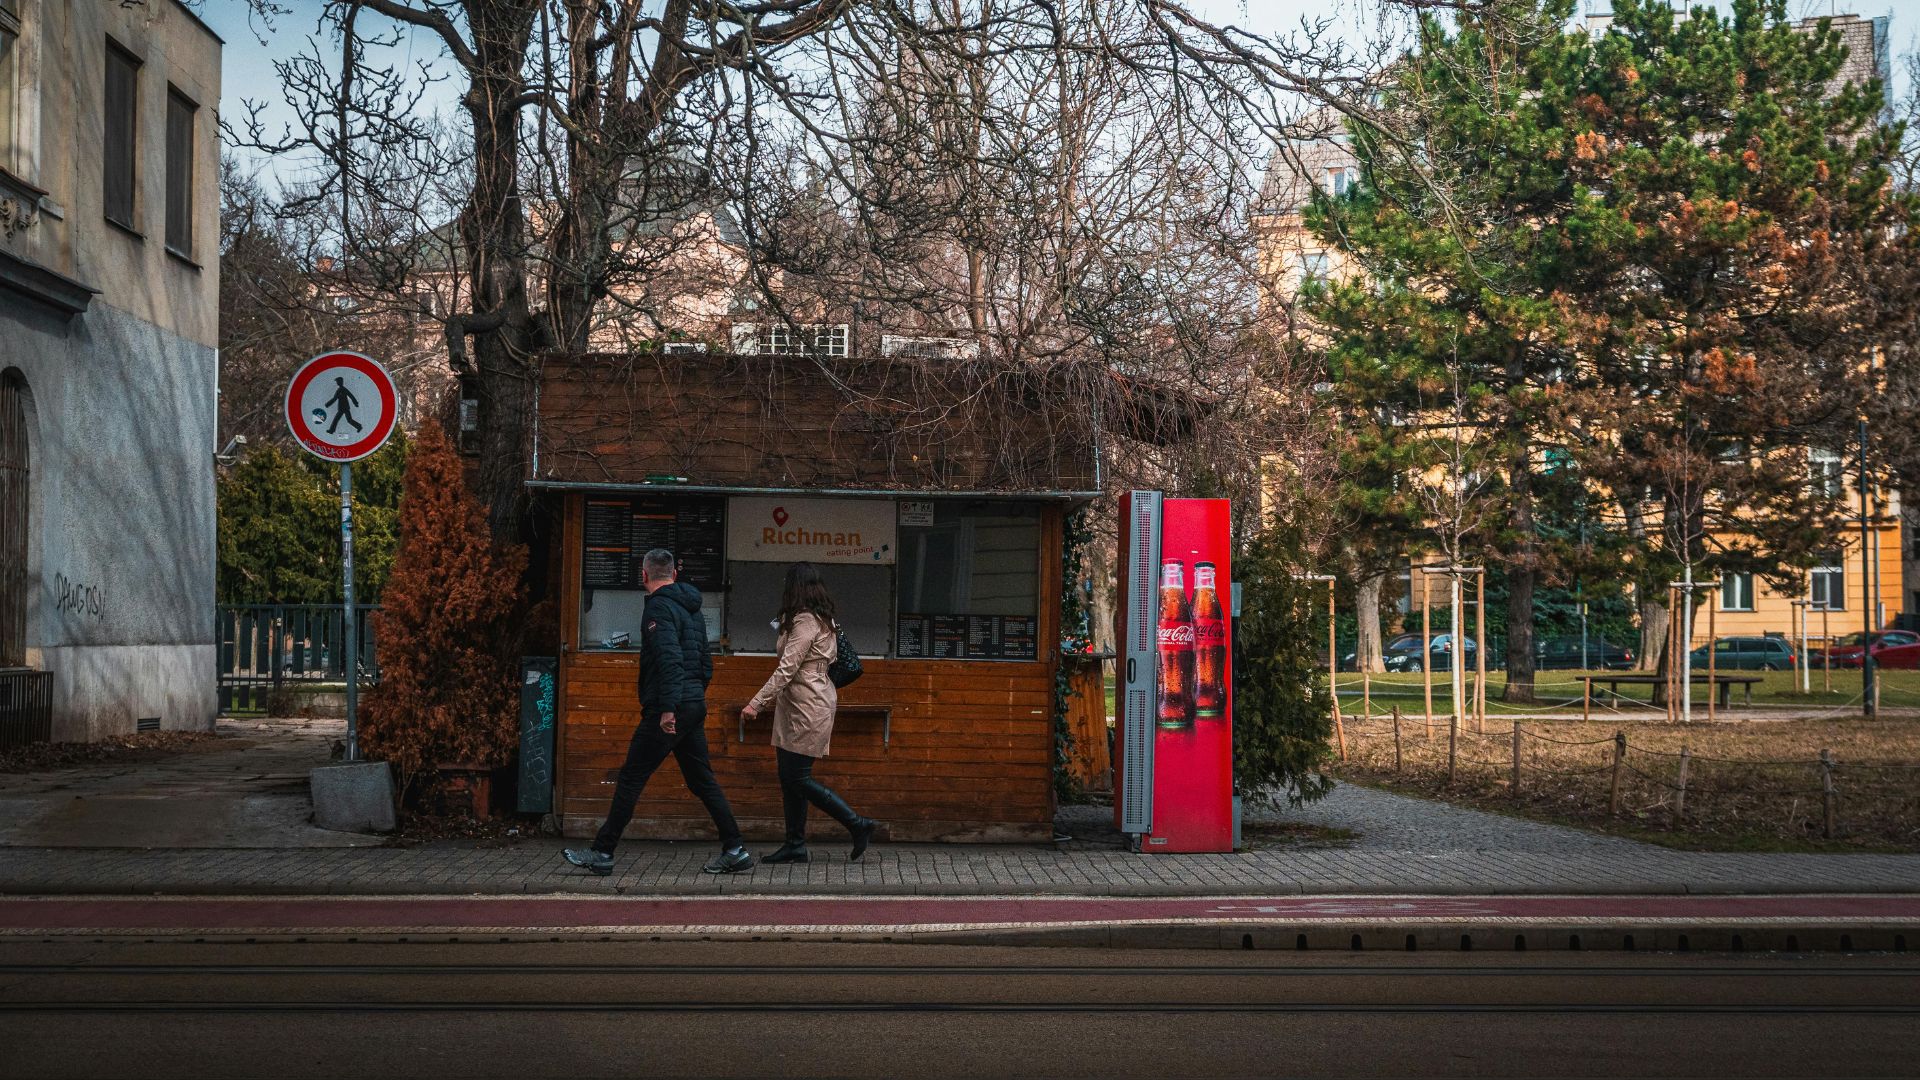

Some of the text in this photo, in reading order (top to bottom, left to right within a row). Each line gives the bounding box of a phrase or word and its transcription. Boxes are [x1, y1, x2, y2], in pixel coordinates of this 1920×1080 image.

[761, 526, 862, 547] Richman
[826, 545, 874, 558] eating point
